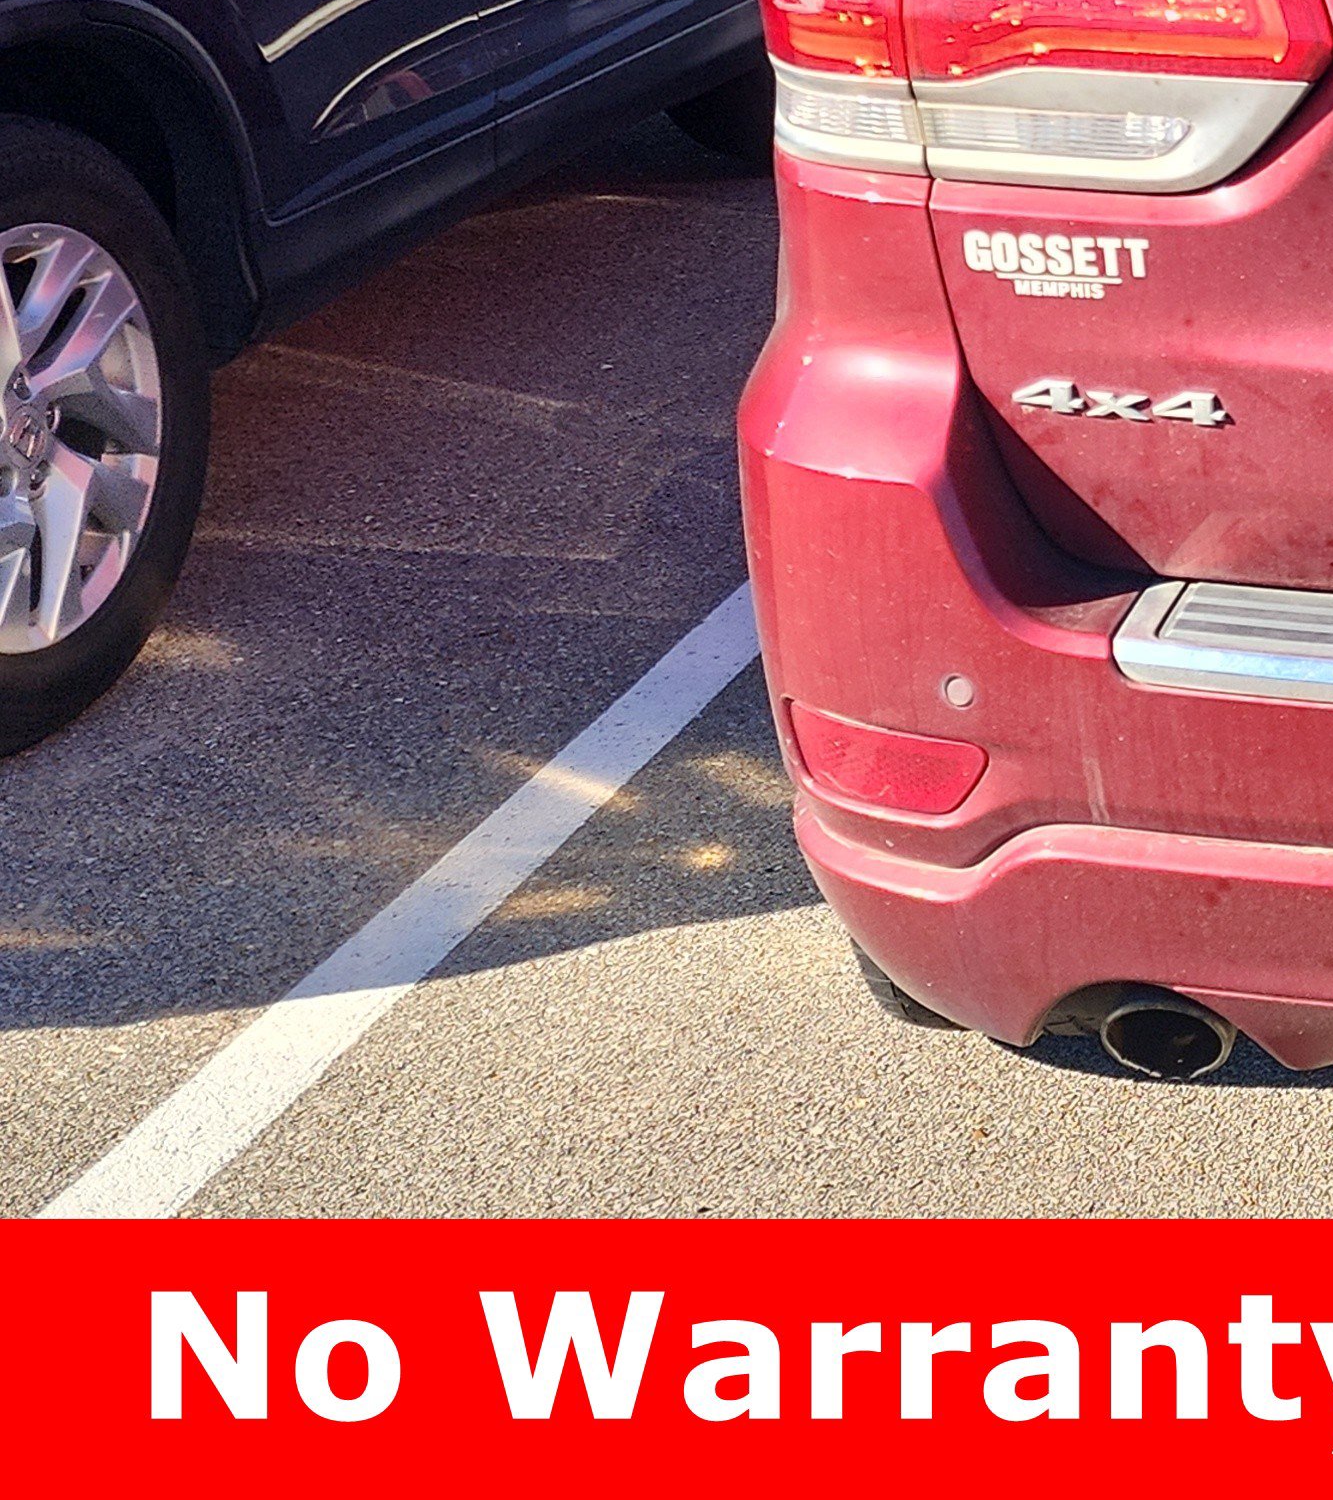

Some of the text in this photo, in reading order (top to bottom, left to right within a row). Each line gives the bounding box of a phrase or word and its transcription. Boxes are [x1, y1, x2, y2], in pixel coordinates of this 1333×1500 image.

[963, 230, 1150, 278] GOSSETT
[1013, 279, 1105, 299] MEMPHIS
[1011, 378, 1230, 428] 4x4
